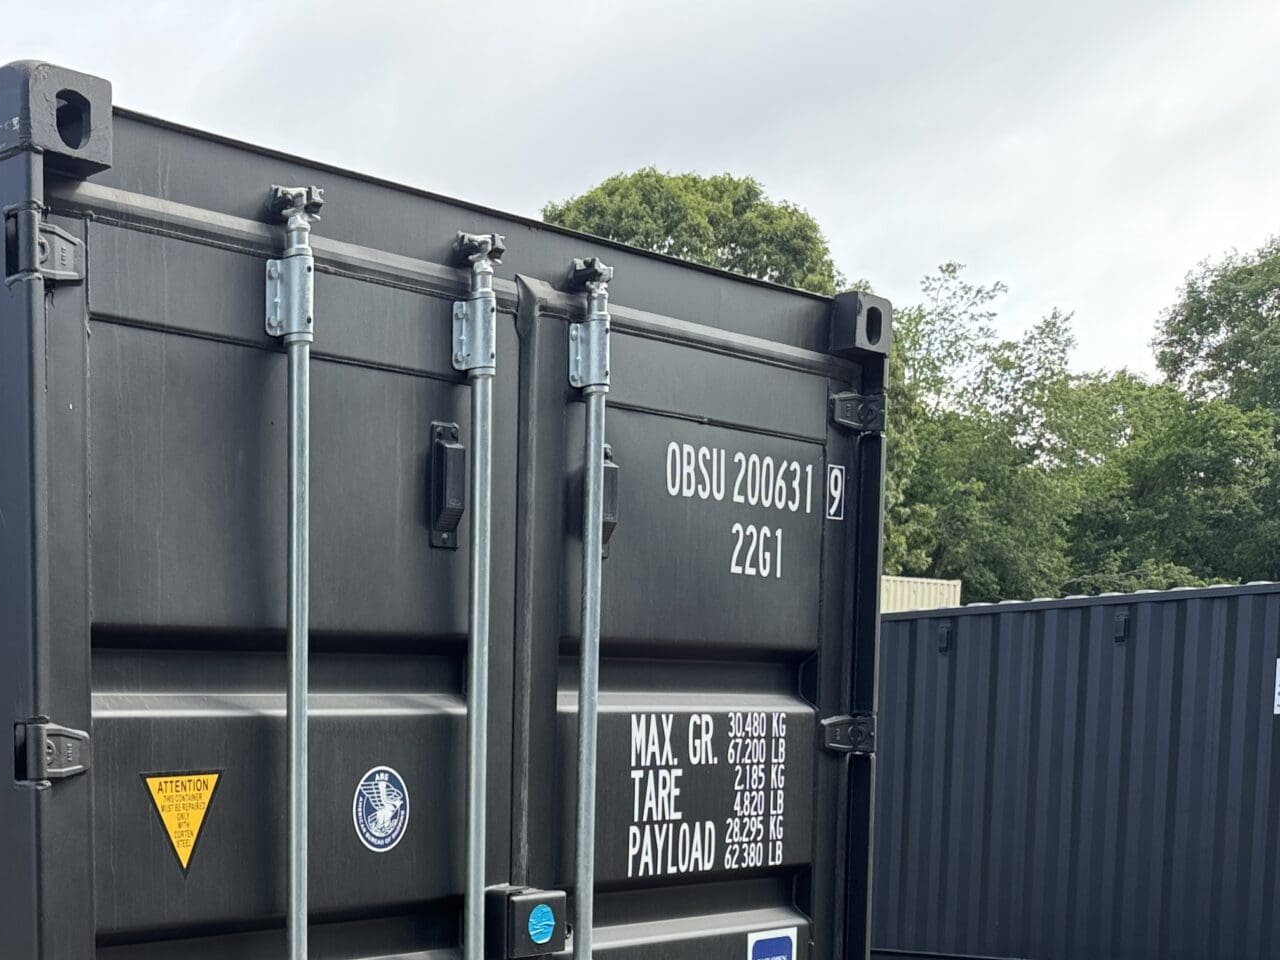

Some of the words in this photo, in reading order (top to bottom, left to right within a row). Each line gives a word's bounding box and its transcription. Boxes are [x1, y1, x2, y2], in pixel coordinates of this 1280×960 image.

[666, 441, 726, 501] OBSU
[732, 451, 813, 514] 200631
[828, 466, 843, 517] 9
[730, 522, 783, 578] 22G1
[631, 713, 678, 767] MAX.
[688, 713, 718, 765] GR.
[771, 712, 786, 737] KG
[771, 739, 786, 763] LB
[157, 779, 209, 794] ATTENTION
[630, 768, 683, 822] TARE
[770, 765, 785, 789] KG
[769, 790, 784, 815] LB
[627, 820, 716, 878] PAYLOAD
[769, 816, 784, 841] KG
[767, 841, 783, 866] LB
